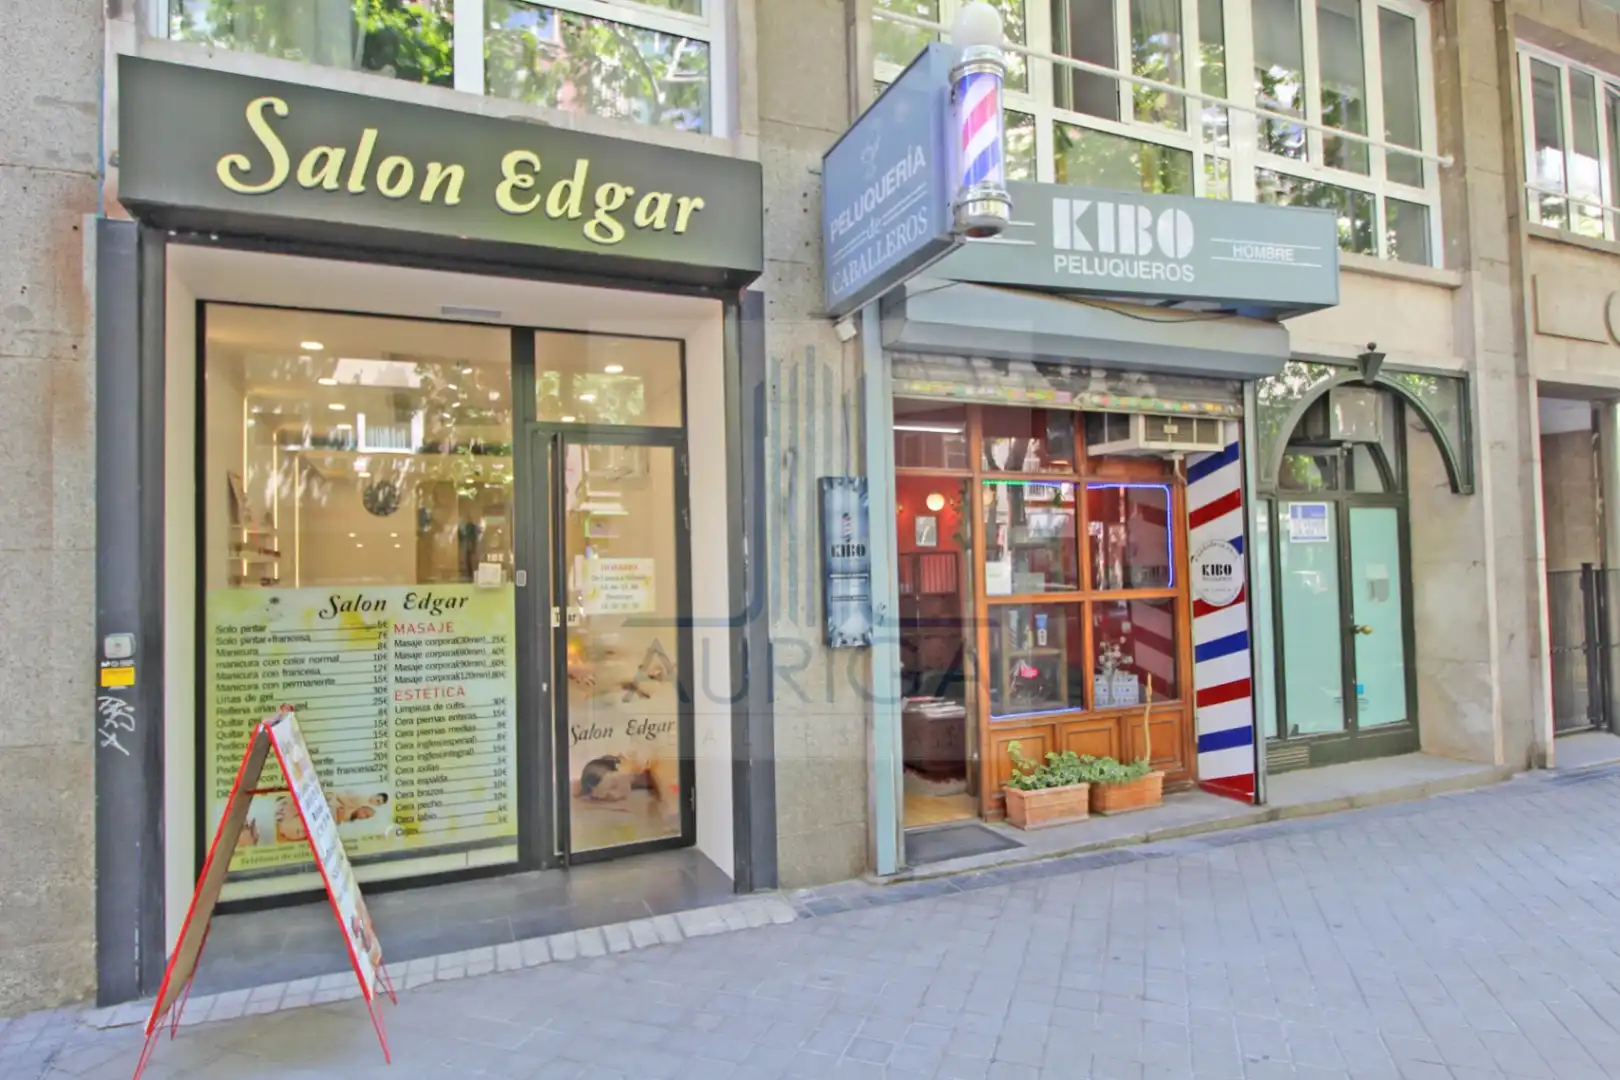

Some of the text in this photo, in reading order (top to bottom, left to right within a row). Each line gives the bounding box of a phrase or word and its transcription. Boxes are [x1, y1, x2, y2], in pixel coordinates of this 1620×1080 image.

[216, 96, 705, 245] Salon Edgar
[830, 144, 926, 244] PELUQUERÍA
[867, 217, 882, 239] de
[1052, 198, 1194, 260] KIBO
[832, 206, 928, 296] CABALLEROS
[1232, 244, 1294, 262] HOMBRE
[1054, 255, 1195, 283] PELUQUEROS
[832, 543, 866, 558] KIBO
[1201, 562, 1232, 577] KIBO
[319, 592, 470, 620] Salon Edgar
[216, 625, 238, 634] Solo
[394, 622, 454, 634] MASAJE
[216, 637, 238, 646] Solo
[394, 639, 422, 648] Masaje
[394, 651, 422, 660] Masaje
[394, 663, 422, 672] Masaje
[394, 676, 422, 684] Masaje
[625, 718, 676, 740] Edgar
